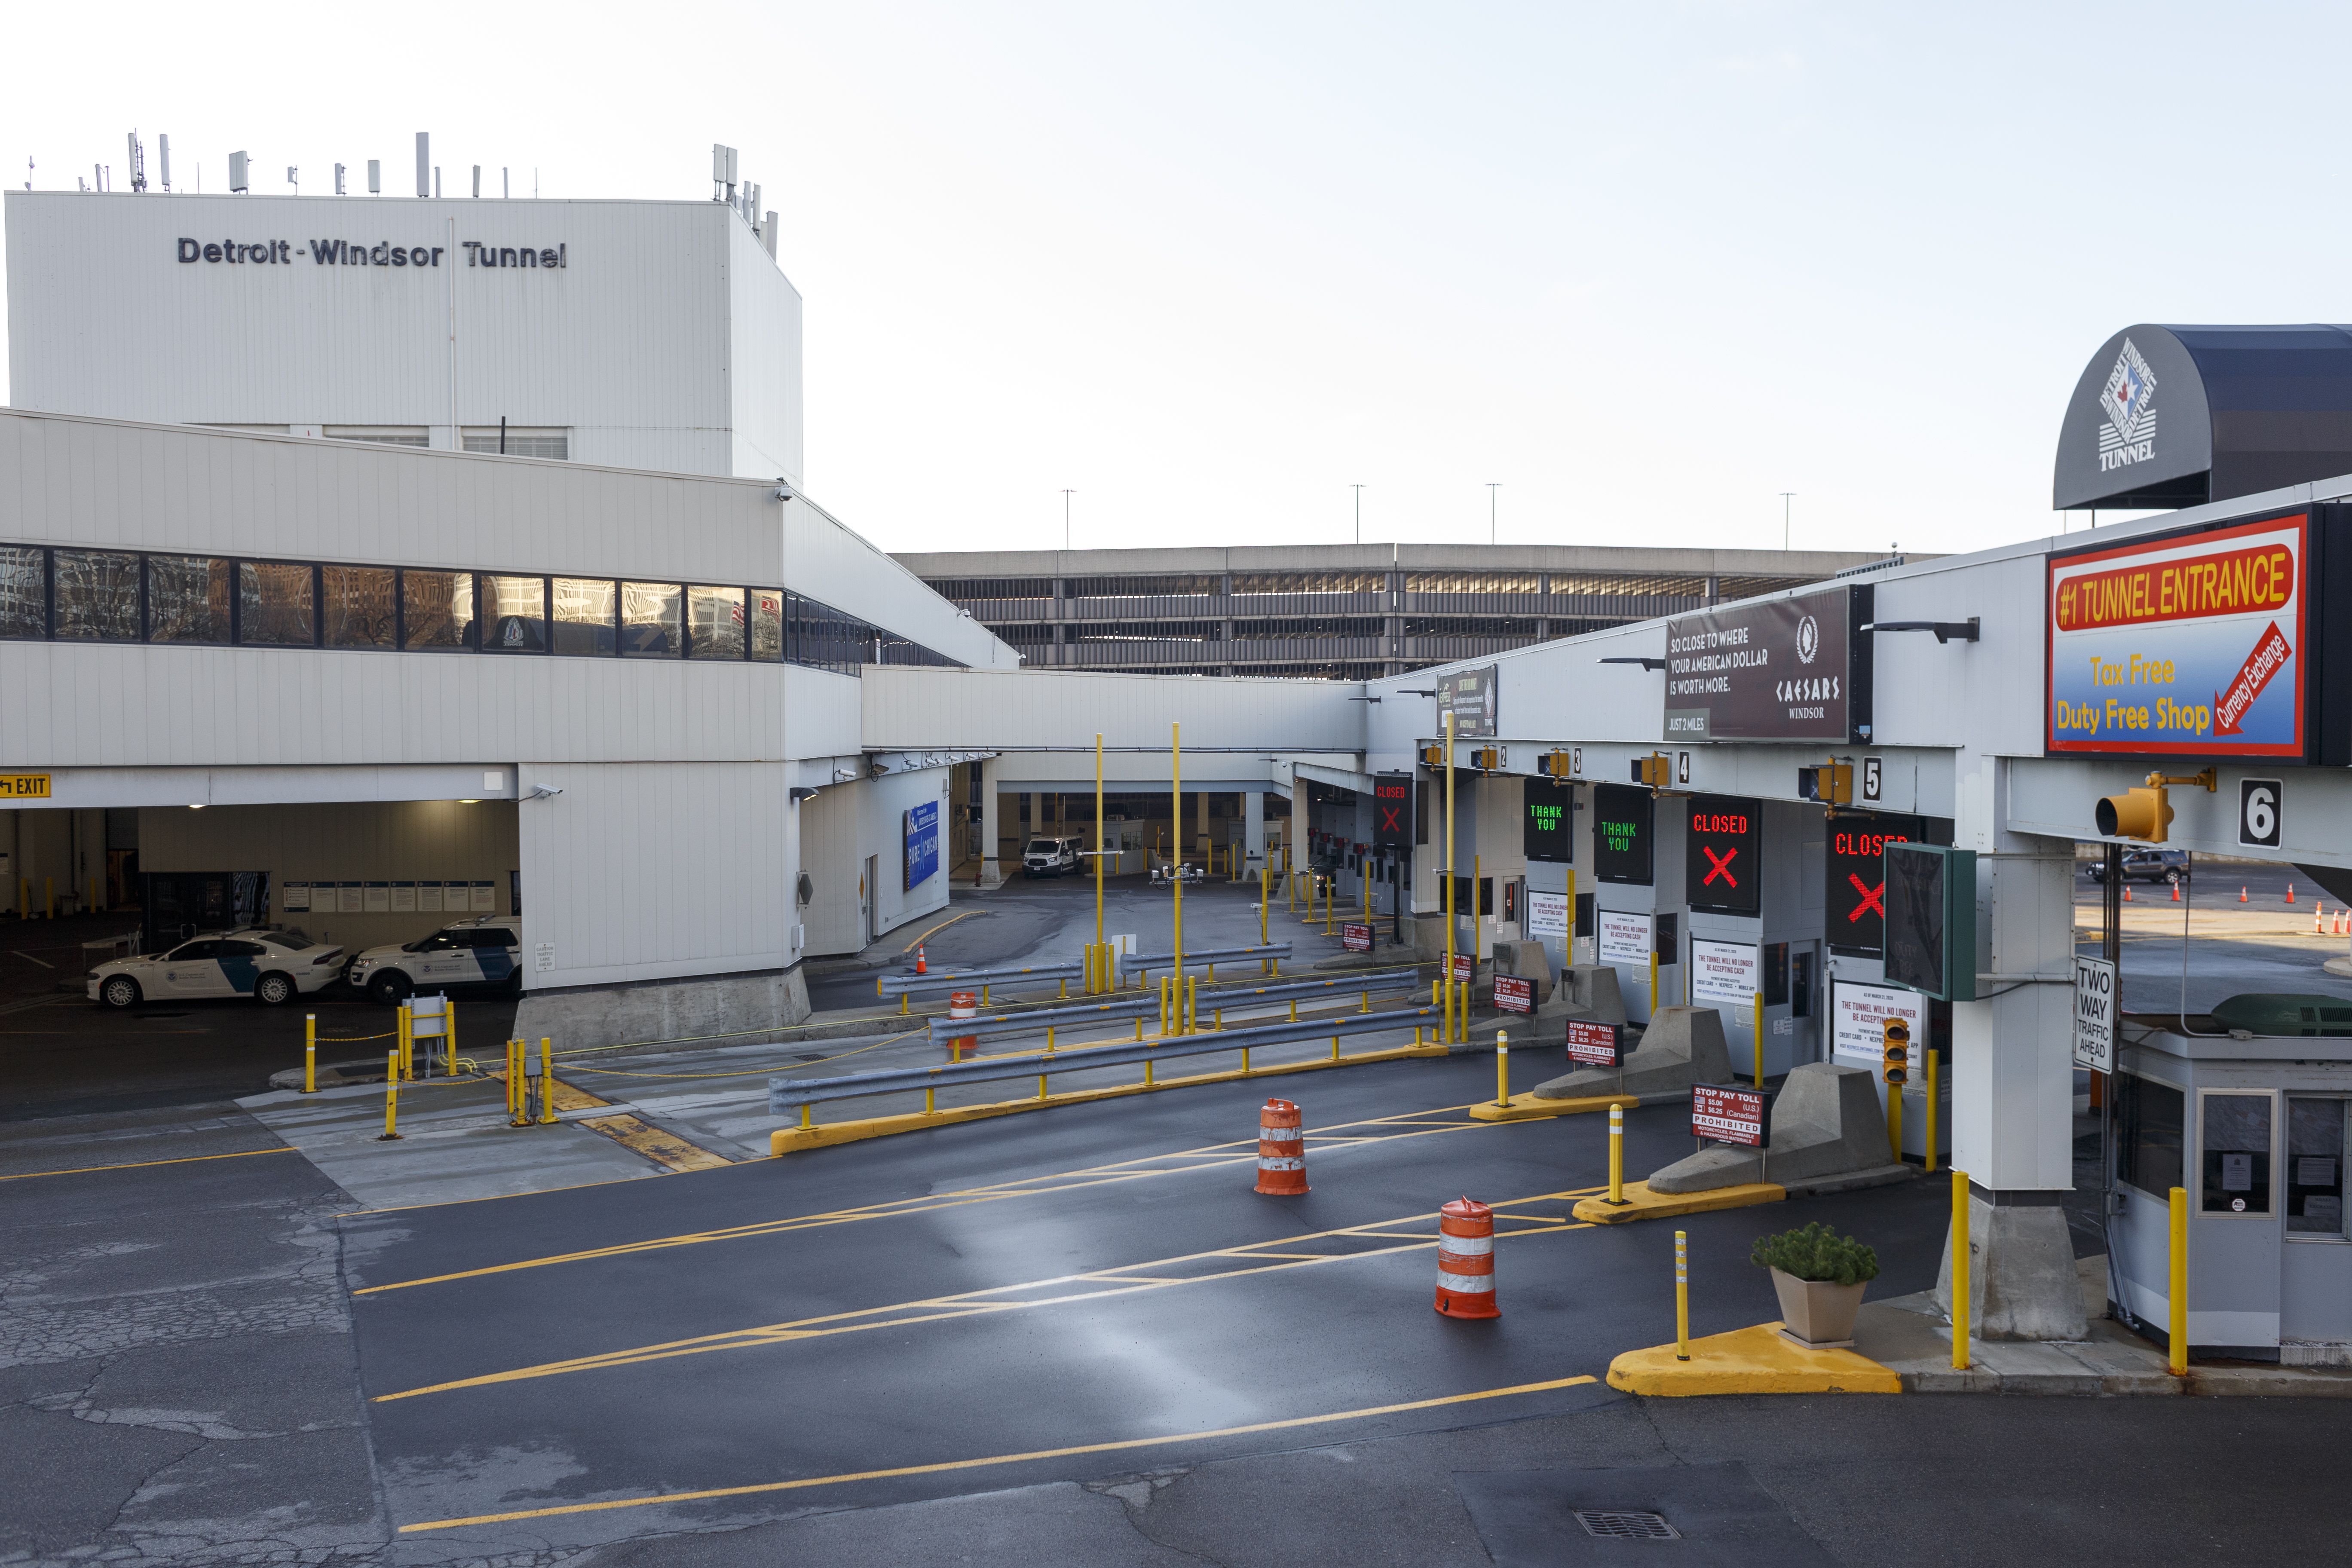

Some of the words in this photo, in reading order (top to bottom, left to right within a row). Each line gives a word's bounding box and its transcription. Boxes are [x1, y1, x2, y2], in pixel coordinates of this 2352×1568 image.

[462, 241, 567, 268] Tunnel
[2122, 337, 2150, 386] WINDSOR
[2100, 352, 2128, 409] DETROIT
[2128, 371, 2158, 432] DETROIT
[2105, 395, 2133, 445] WINDSOR
[2099, 439, 2156, 472] TUNNEL
[2060, 584, 2076, 626] #1
[2082, 572, 2155, 623] TUNNEL
[2160, 552, 2286, 614] ENTRANCE
[1671, 638, 1681, 653] SO
[1682, 634, 1705, 652] CLOSE
[1707, 632, 1717, 648] TO
[1719, 627, 1748, 646] WHERE
[1671, 658, 1690, 674] YOUR
[1691, 653, 1731, 672] AMERICAN
[1733, 649, 1768, 668] DOLLAR
[2090, 657, 2123, 686] Tax
[2130, 653, 2175, 685] Free
[1670, 680, 1676, 695] IS
[1678, 678, 1704, 695] WORTH
[1706, 677, 1730, 693] MORE.
[1776, 676, 1840, 702] CAESARS
[2217, 678, 2250, 729] Currency
[2244, 634, 2286, 691] Exchange
[1789, 707, 1824, 720] WINDSOR
[2057, 700, 2100, 735] Duty
[2106, 698, 2149, 730] Free
[2156, 697, 2210, 735] Shop
[1669, 718, 1682, 731] JUST
[1682, 719, 1686, 730] 2
[1687, 717, 1703, 731] MILES
[1502, 748, 1505, 765] 2
[1575, 750, 1580, 772] 3
[1680, 756, 1687, 780] 4
[16, 778, 45, 794] EXIT
[1865, 763, 1878, 796] 5
[1377, 786, 1404, 798] CLOSED
[1531, 805, 1562, 818] THANK
[2247, 787, 2275, 839] 6
[1537, 819, 1555, 830] YOU
[1602, 822, 1636, 836] THANK
[1694, 815, 1747, 834] CLOSED
[1609, 838, 1629, 851] YOU
[909, 844, 919, 867] PURE
[1712, 965, 1733, 974] ACCEPTING
[1738, 959, 1753, 967] LONGER
[2079, 966, 2110, 994] TWO
[1496, 994, 1529, 1004] PROHIBITED
[2080, 993, 2107, 1020] WAY
[1842, 1001, 1851, 1010] THE
[1852, 1002, 1872, 1013] TUNNEL
[1873, 1005, 1886, 1014] WILL
[1887, 1007, 1894, 1015] NO
[1896, 1008, 1916, 1018] LONGER
[1853, 1013, 1859, 1021] BE
[2077, 1019, 2108, 1041] TRAFFIC
[1570, 1045, 1613, 1055] PROHIBITED
[1591, 1038, 1613, 1047] (Canadian)
[2079, 1038, 2105, 1058] AHEAD
[1695, 1088, 1717, 1096] STOP
[1719, 1091, 1735, 1099] PAY
[1738, 1093, 1760, 1103] TOLL
[1708, 1098, 1723, 1106] $5.00
[1743, 1103, 1759, 1113] (U.S.)
[1695, 1116, 1758, 1132] PROHIBITED
[1727, 1109, 1759, 1121] (Canadian)
[1698, 1125, 1728, 1134] MOTORCYCLES,
[1729, 1130, 1754, 1139] FLAMMABLE
[1729, 1135, 1752, 1144] MATERIALS
